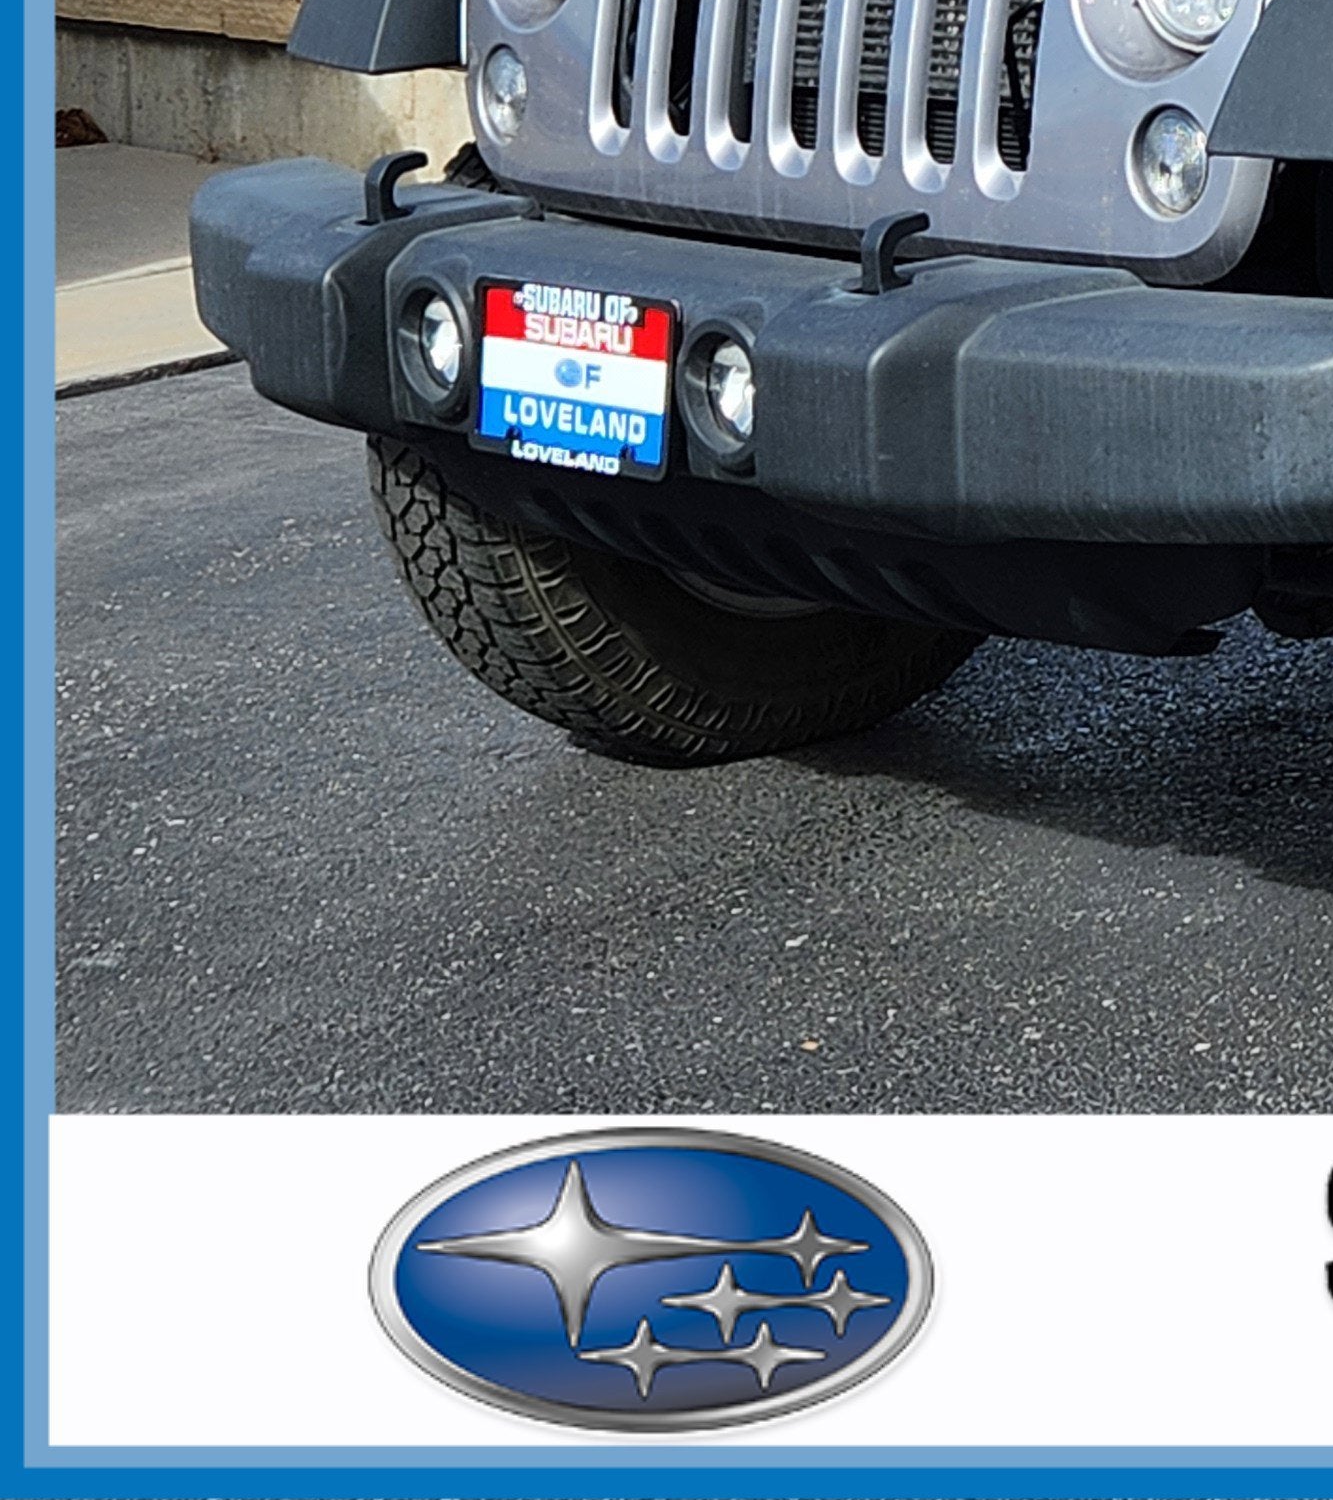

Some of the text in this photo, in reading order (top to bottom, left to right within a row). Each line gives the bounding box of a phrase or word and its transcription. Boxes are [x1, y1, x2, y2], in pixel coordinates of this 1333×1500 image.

[521, 283, 632, 324] SUBARU OF
[524, 312, 634, 353] SUBARU
[554, 357, 602, 390] OF
[502, 393, 648, 446] LOVELAND
[510, 439, 621, 477] LOVELAND
